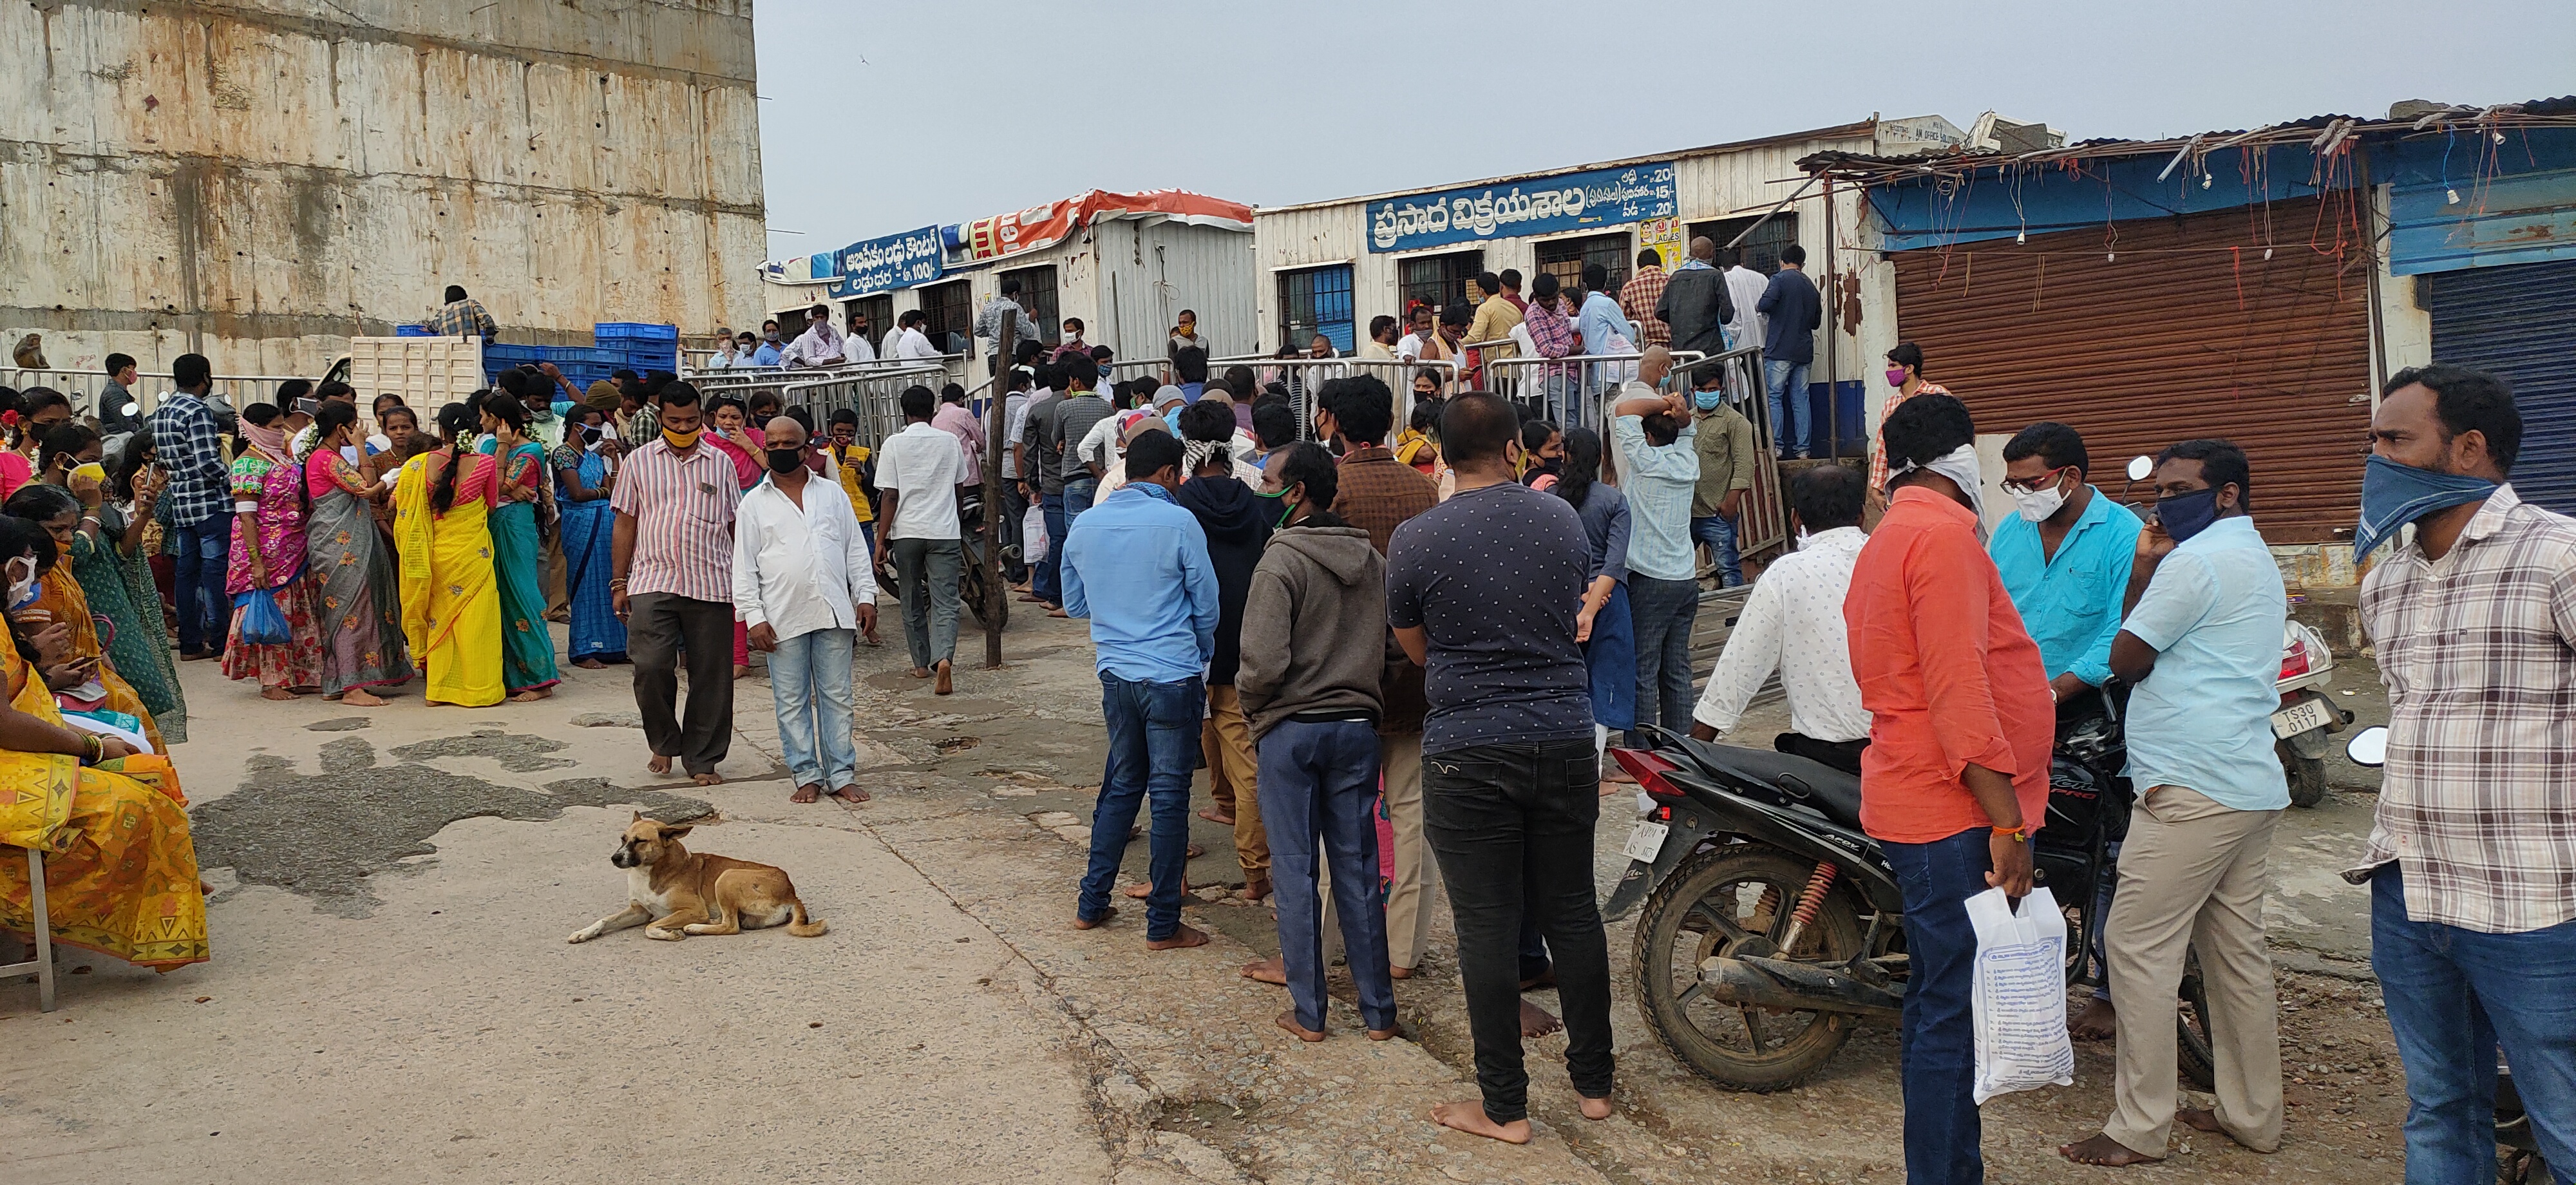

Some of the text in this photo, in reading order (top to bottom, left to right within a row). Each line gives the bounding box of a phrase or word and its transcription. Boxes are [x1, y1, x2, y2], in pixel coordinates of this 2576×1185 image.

[1374, 196, 1448, 248] ప్రసాద
[1452, 187, 1585, 236] విక్రయశాల
[846, 243, 884, 274] అభిషేకం
[905, 228, 936, 260] కౌంటర్
[2282, 704, 2314, 723] TS30
[2288, 714, 2317, 732] 0117
[2050, 788, 2096, 799] PRO
[1638, 826, 1657, 839] AP24
